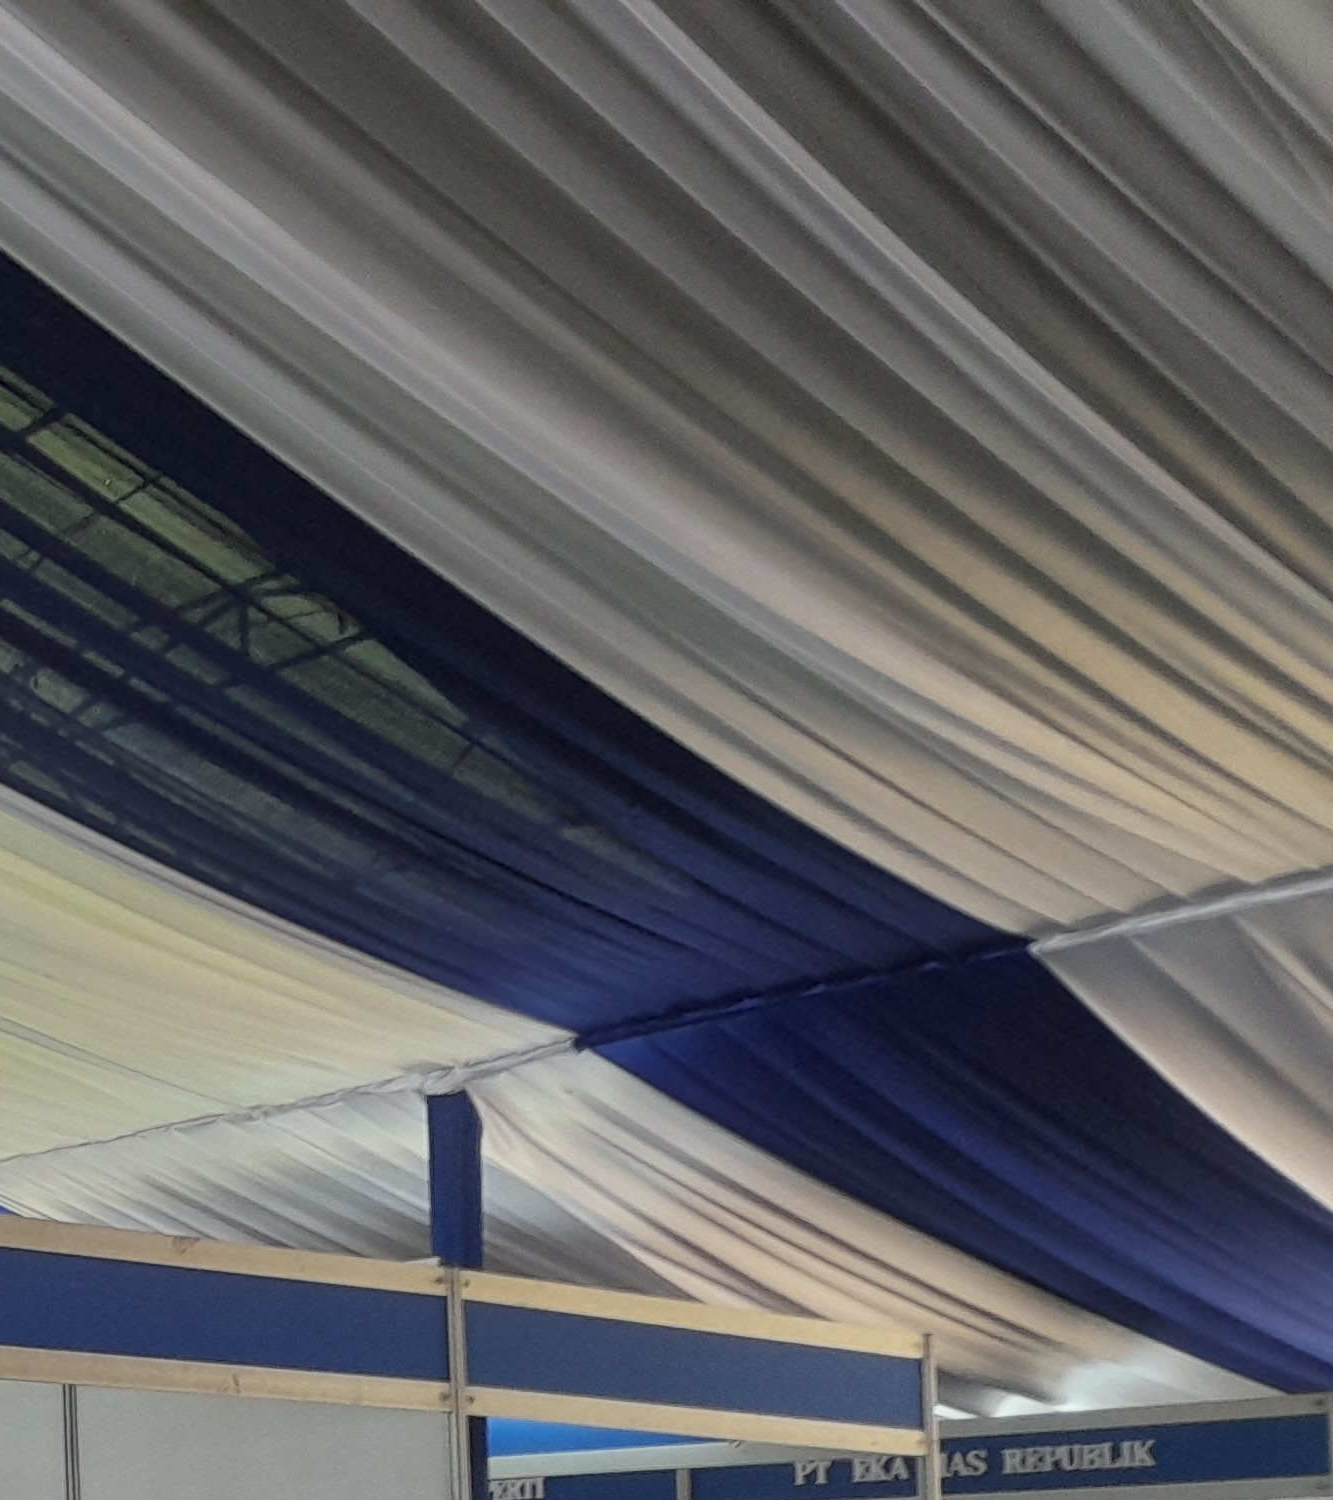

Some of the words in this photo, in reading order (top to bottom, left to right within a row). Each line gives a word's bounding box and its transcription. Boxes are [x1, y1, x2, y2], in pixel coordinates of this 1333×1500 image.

[793, 1457, 833, 1486] PT
[851, 1455, 910, 1483] EKA
[1001, 1439, 1157, 1475] REPUBLIK
